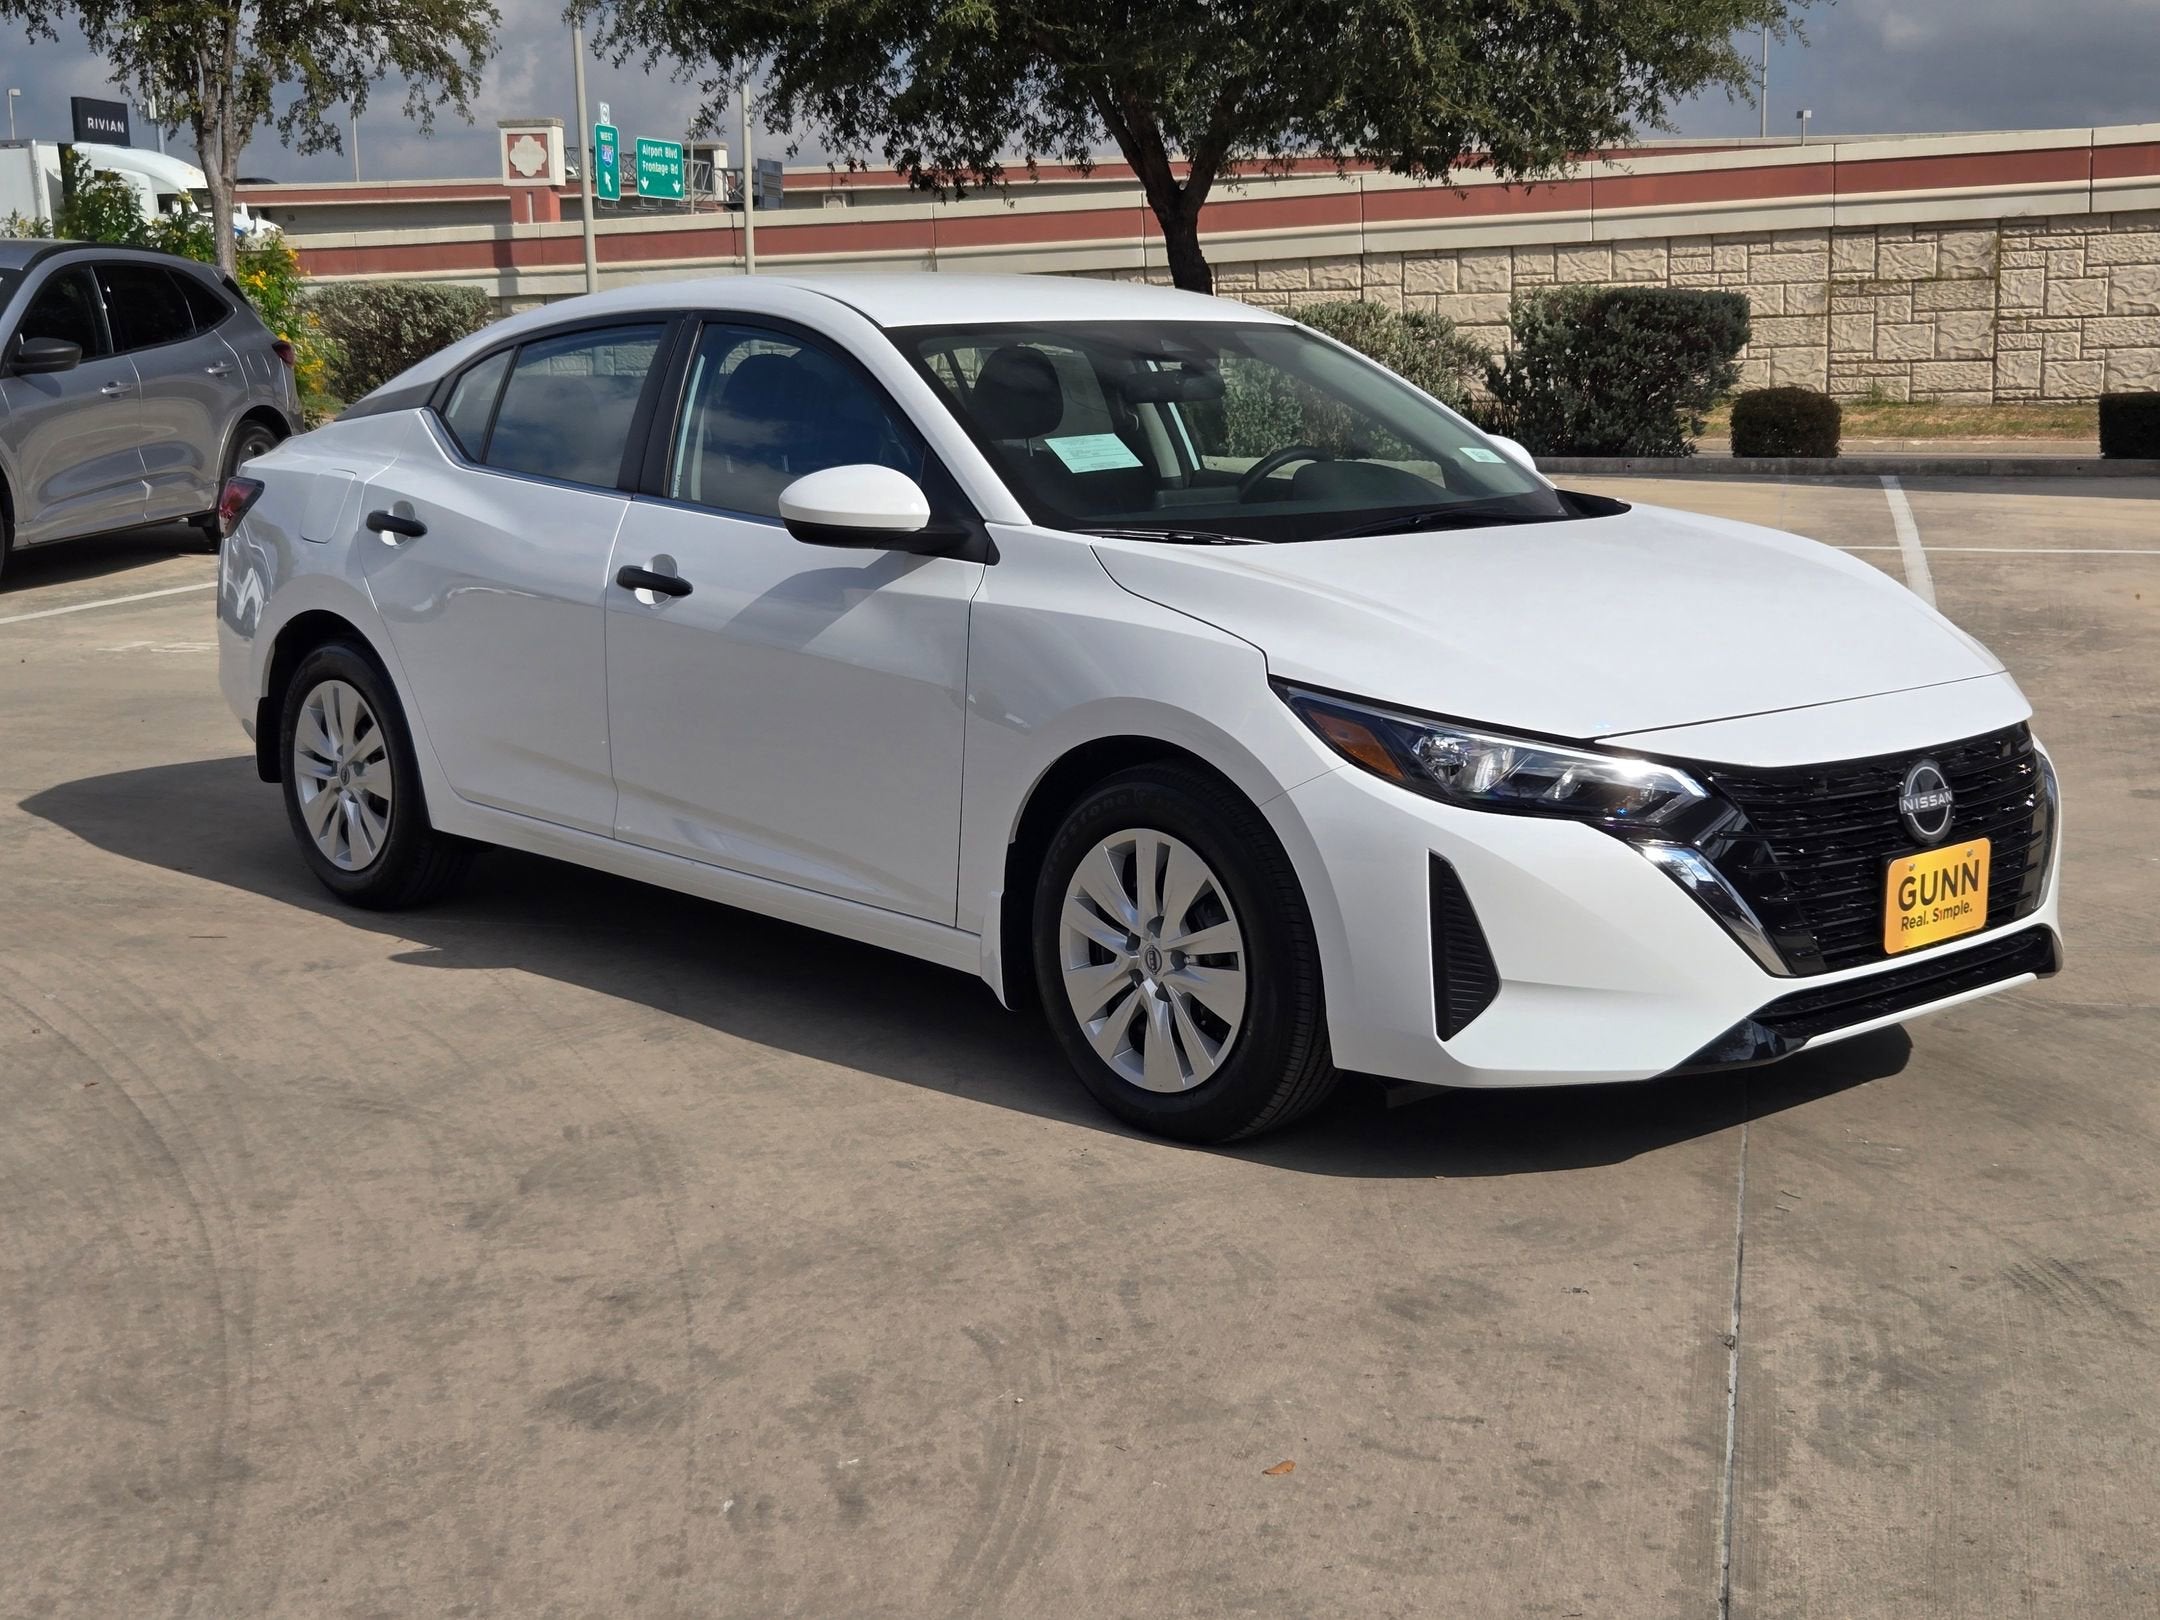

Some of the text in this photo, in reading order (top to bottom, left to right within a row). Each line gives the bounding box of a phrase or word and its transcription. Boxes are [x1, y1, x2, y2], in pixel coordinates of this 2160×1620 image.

[87, 117, 125, 134] RIVIAN
[600, 131, 613, 141] WEST
[642, 144, 677, 159] Airport Blvd
[642, 160, 678, 176] Frontage Rd
[1902, 790, 1953, 812] NISSAN
[1898, 859, 1980, 912] GUNN
[1901, 910, 1929, 932] Real.
